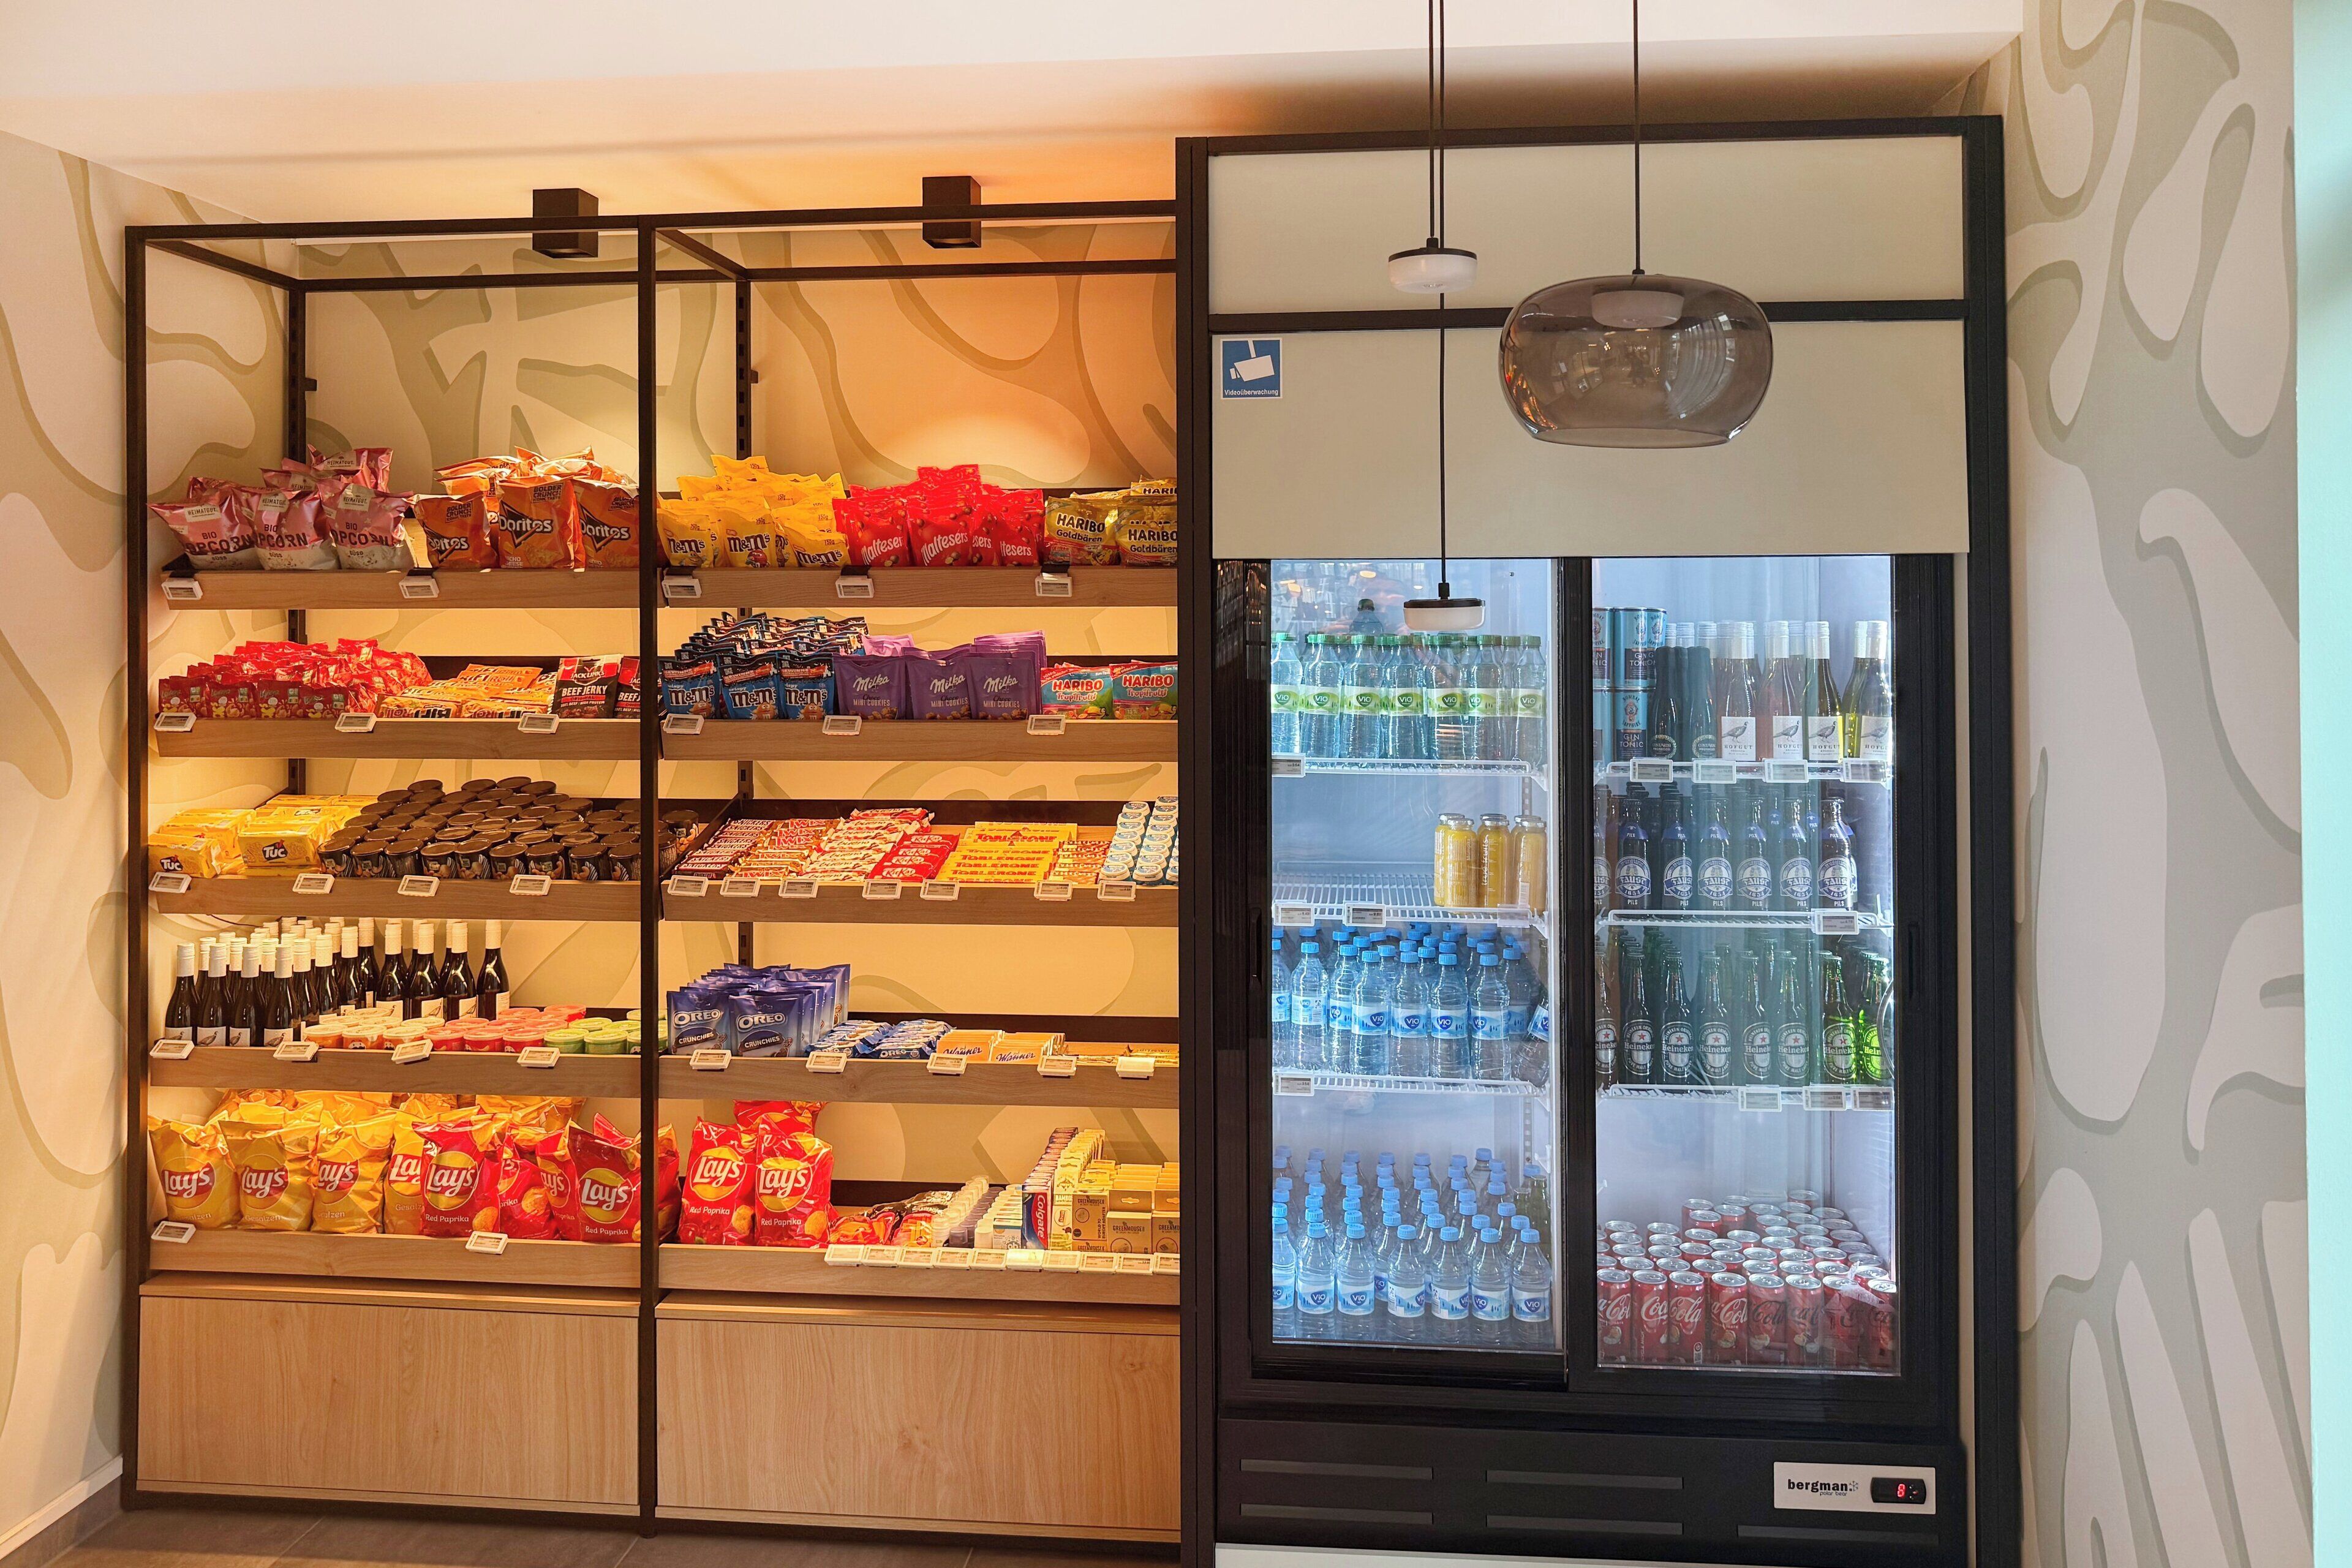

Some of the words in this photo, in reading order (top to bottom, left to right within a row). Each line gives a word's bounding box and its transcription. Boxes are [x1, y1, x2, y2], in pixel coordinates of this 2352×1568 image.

[447, 503, 471, 512] BOLDER
[345, 522, 358, 530] BIO
[499, 516, 552, 532] Doritos
[581, 519, 630, 539] Doritos
[1056, 513, 1106, 533] HARIBO
[1057, 529, 1102, 543] Goldbären
[1128, 529, 1177, 542] HARIBO
[921, 531, 968, 567] Maltesers
[1130, 545, 1177, 554] Goldbären
[853, 674, 889, 692] Milka
[930, 674, 965, 693] Milka
[983, 674, 1019, 693] Milka
[1053, 679, 1104, 692] HARIBO
[1123, 674, 1174, 687] HARIBO
[562, 687, 582, 696] BEEF
[582, 685, 608, 695] JERKY
[618, 692, 636, 701] BEEF
[946, 697, 968, 706] COOKIES
[674, 1009, 720, 1025] OREO
[738, 1013, 785, 1029] OREO
[679, 1031, 714, 1044] CRUNCHIES
[744, 1036, 780, 1048] CRUNCHIES
[1699, 1044, 1732, 1053] Heineken
[693, 1156, 743, 1188] Lay's
[164, 1166, 212, 1199] Lay's
[242, 1166, 285, 1199] Lay's
[426, 1164, 475, 1197] Lay's
[759, 1168, 808, 1199] Lay's
[581, 1179, 629, 1211] Lay's
[703, 1206, 730, 1215] Paprika
[1036, 1194, 1046, 1238] Colgate
[426, 1214, 438, 1223] Red
[440, 1215, 469, 1224] Paprika
[774, 1218, 802, 1227] Paprika
[586, 1226, 597, 1235] Red
[600, 1227, 629, 1236] Paprika
